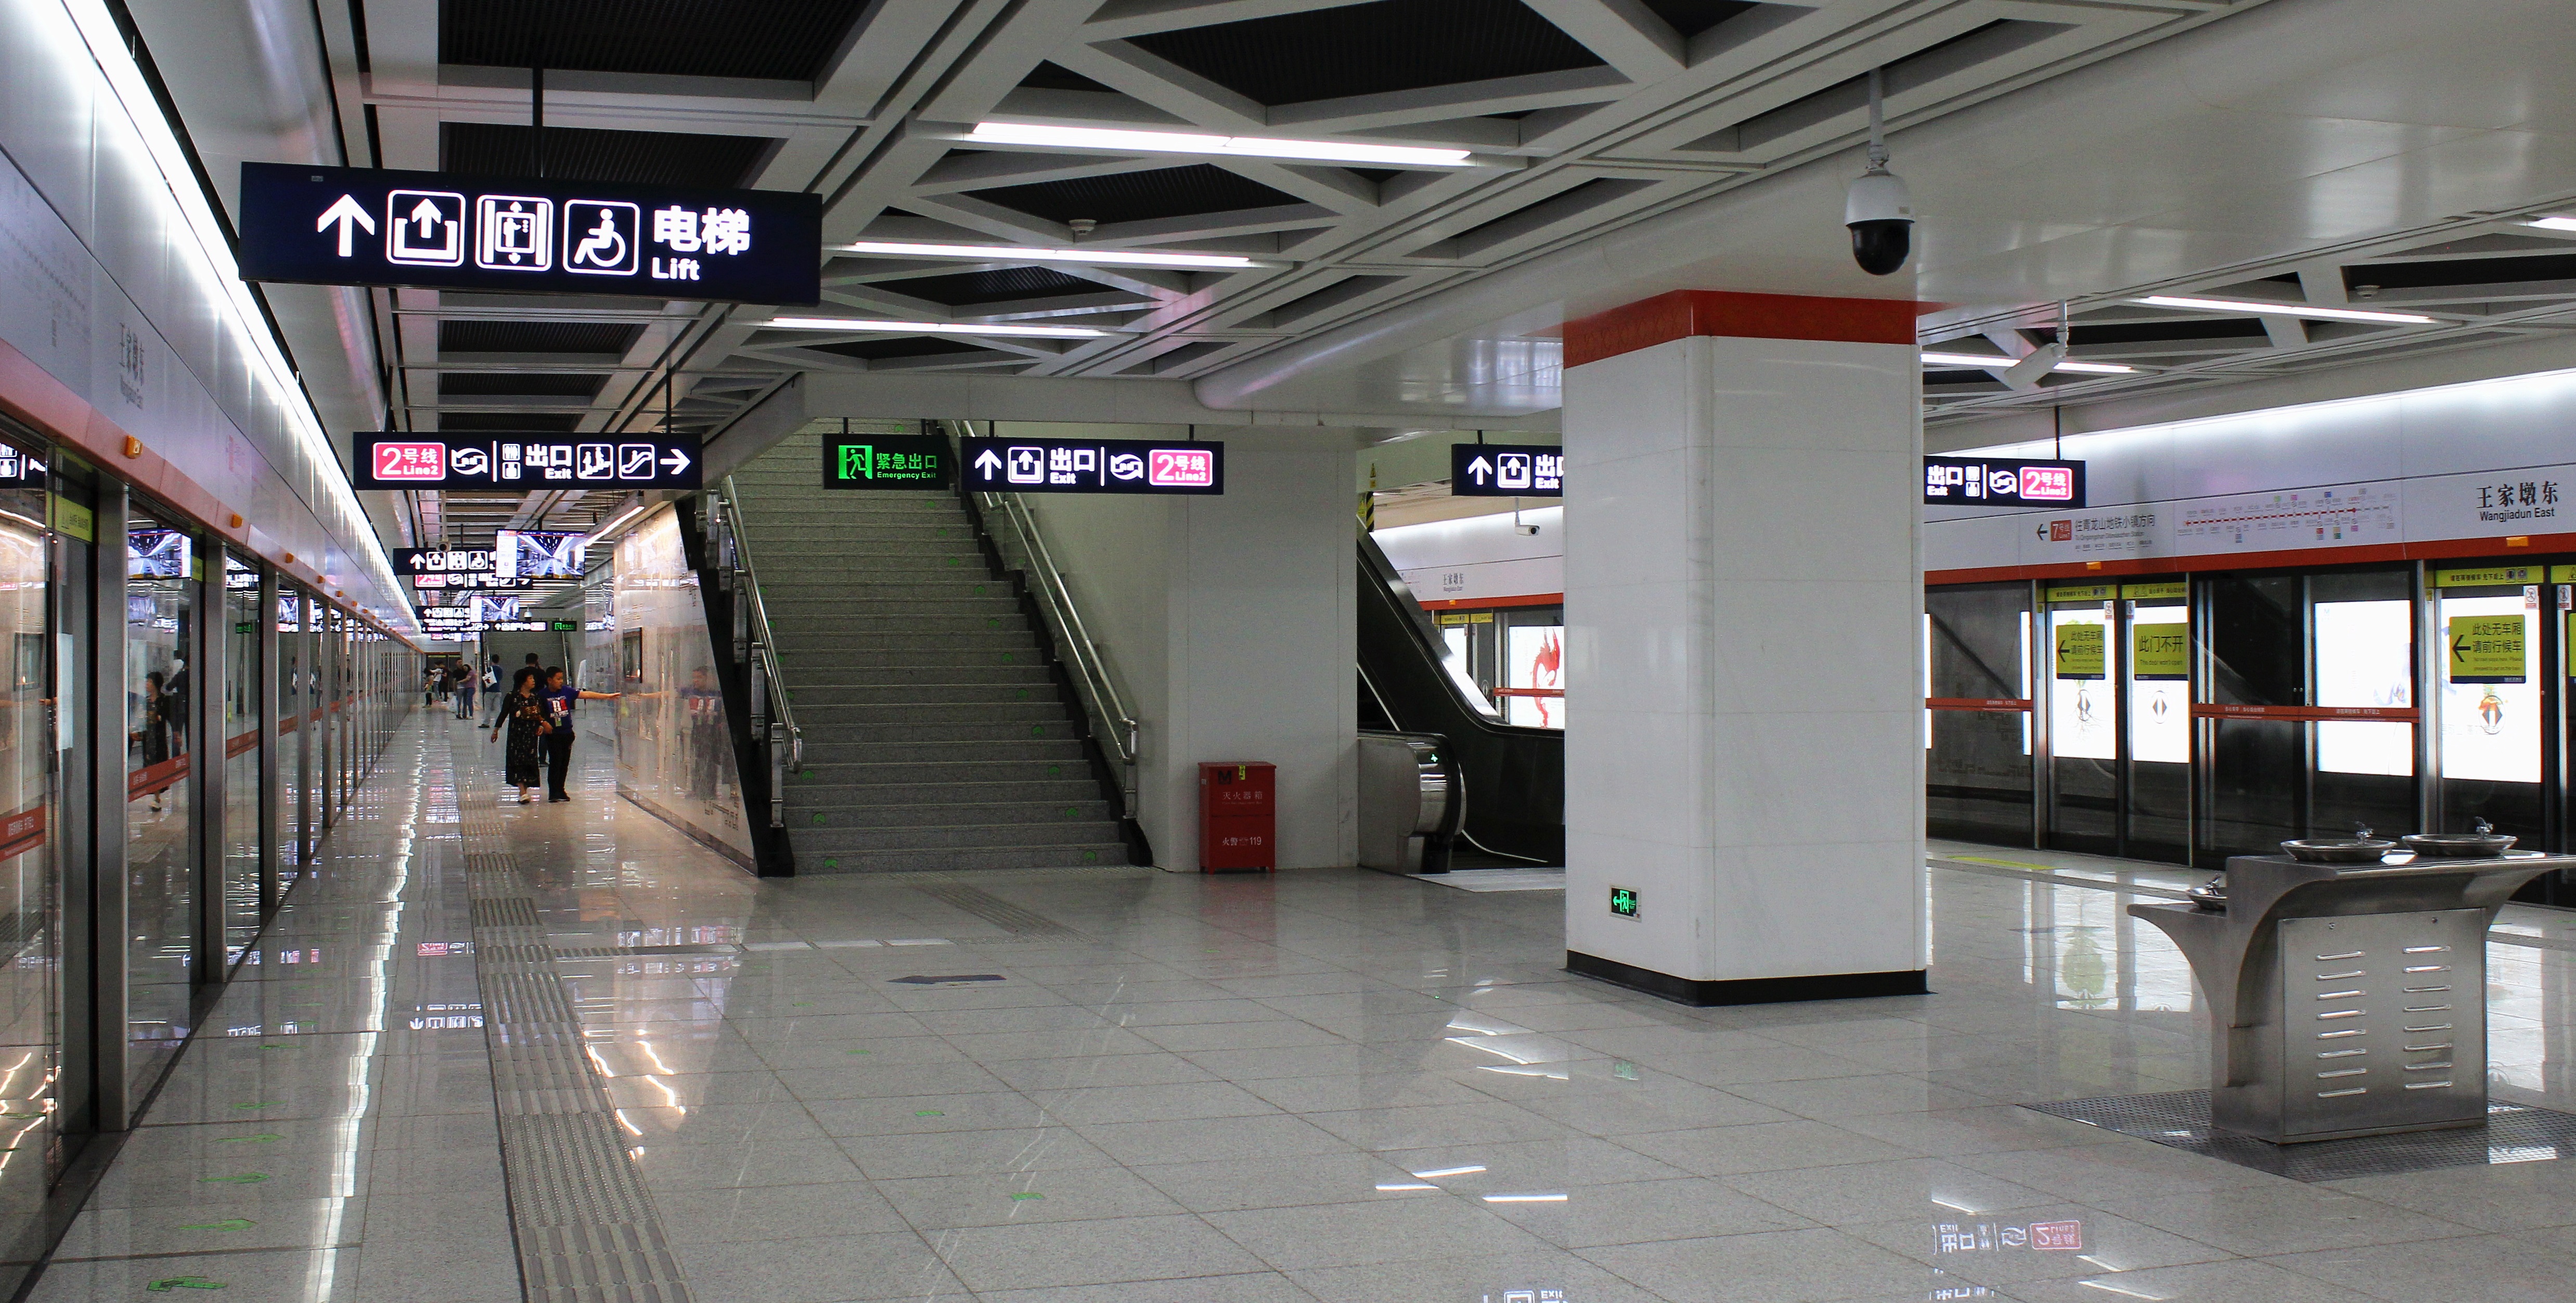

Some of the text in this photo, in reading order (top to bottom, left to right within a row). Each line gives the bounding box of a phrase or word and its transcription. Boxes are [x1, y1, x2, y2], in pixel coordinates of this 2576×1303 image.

[654, 205, 750, 255] 电梯
[652, 257, 700, 280] Lift
[381, 446, 439, 475] 2号线
[525, 444, 572, 467] 出口
[877, 453, 936, 469] 紧急出口
[1050, 448, 1095, 471] 出口
[545, 468, 572, 480] Exit
[1156, 454, 1206, 480] 2号线
[1927, 465, 1963, 485] 出口
[1050, 472, 1076, 484] Exit
[1535, 477, 1560, 489] Exit
[2026, 471, 2066, 495] 2号线
[1927, 486, 1949, 496] Exit
[2477, 480, 2558, 508] 王家墩东
[2480, 507, 2555, 522] Wangjiadun East
[2472, 622, 2522, 635] 此处无车厢
[2139, 635, 2183, 653] 此门不开
[2472, 639, 2522, 654] 请前行候车
[1222, 791, 1263, 800] 灭火器箱
[1250, 836, 1261, 846] 119
